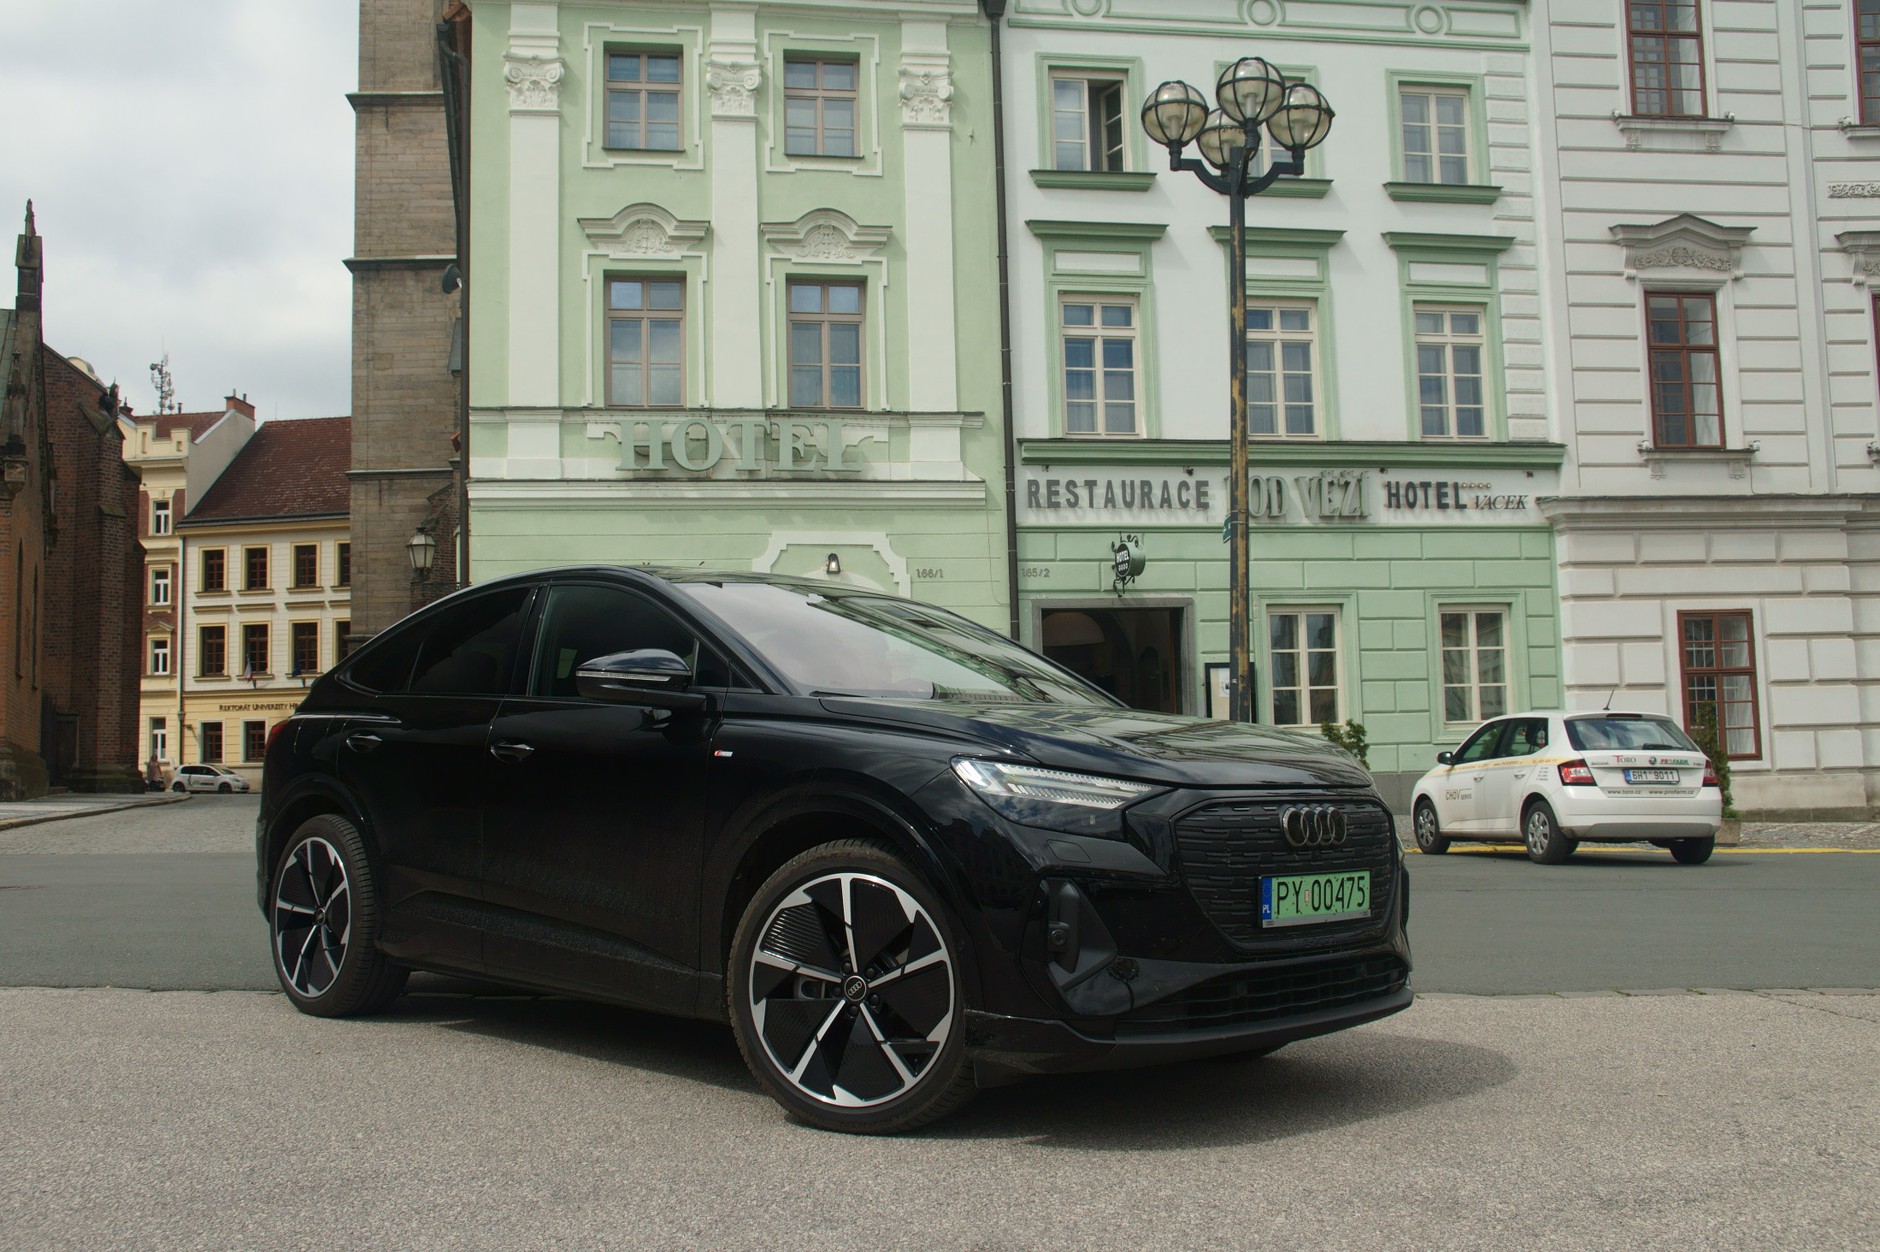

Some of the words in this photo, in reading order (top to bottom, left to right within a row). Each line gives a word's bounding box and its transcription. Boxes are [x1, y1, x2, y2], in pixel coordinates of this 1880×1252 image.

[615, 418, 862, 473] HOTEL
[1027, 479, 1210, 510] RESTAURACE
[1225, 475, 1290, 518] OD
[1386, 481, 1468, 510] HOTEL
[916, 568, 944, 578] 166/1
[1021, 567, 1050, 578] 165/2
[1660, 758, 1690, 766] PROFARM
[1632, 770, 1647, 780] 6H1
[1654, 770, 1675, 780] 9011
[1649, 788, 1694, 797] www.profarm.cz
[1277, 880, 1303, 915] PY
[1311, 876, 1365, 912] 00475
[1262, 904, 1271, 914] PL
